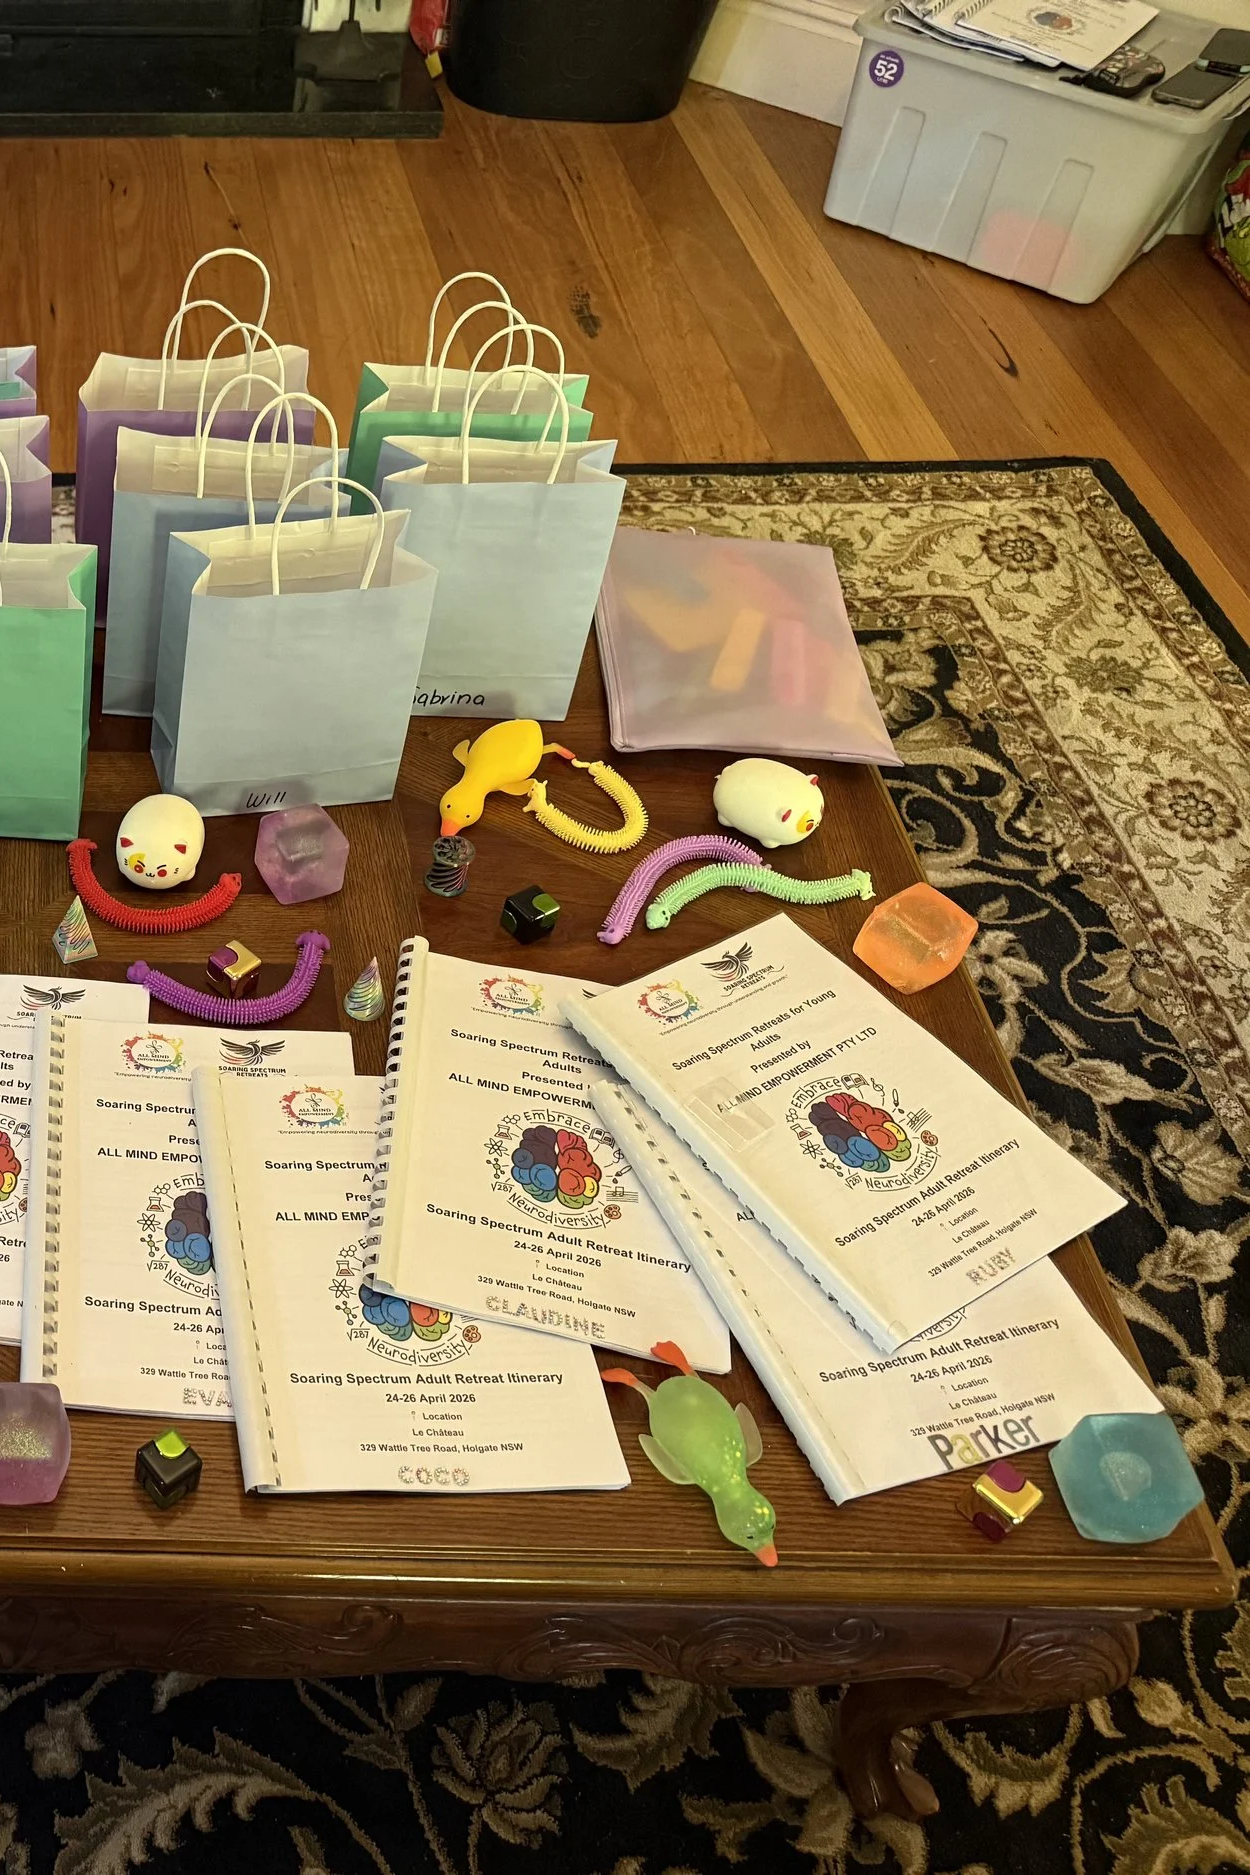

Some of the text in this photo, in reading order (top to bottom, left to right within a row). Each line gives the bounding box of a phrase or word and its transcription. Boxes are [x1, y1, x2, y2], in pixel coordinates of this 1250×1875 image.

[874, 60, 898, 80] 52
[246, 792, 286, 809] Will
[672, 990, 837, 1072] Soaring Spectrum Retreats for Young
[750, 1034, 781, 1051] Adults
[717, 1027, 876, 1114] ALL MIND EMPOWERMENT PTY LTD
[750, 1041, 811, 1073] Presented by
[18, 1080, 31, 1090] by
[793, 1076, 841, 1108] Embrace
[524, 1110, 590, 1133] Embrace
[865, 1147, 941, 1190] Neurodiversity
[835, 1138, 1020, 1246] Soaring Spectrum Adult Retreat Itinerary
[912, 1187, 975, 1226] 24-26 April 2026
[509, 1194, 607, 1228] Neurodiversity
[427, 1204, 693, 1273] Soaring Spectrum Adult Retreat Itinerary
[966, 1248, 1015, 1285] RUBY
[85, 1296, 201, 1315] Soaring Spectrum
[485, 1296, 606, 1339] CLAUDINE
[368, 1338, 469, 1365] Neurodiversity
[819, 1319, 1059, 1382] Soaring Spectrum Adult Retreat Itinerary
[290, 1373, 562, 1386] Soaring Spectrum Adult Retreat Itinerary
[911, 1355, 992, 1382] 24-26 April 2026
[183, 1388, 232, 1407] EVA
[386, 1394, 476, 1405] 24-26 April 2026
[410, 1444, 431, 1452] Tree
[433, 1445, 460, 1453] Road,
[462, 1445, 498, 1453] Holgate
[501, 1443, 523, 1451] NSW
[928, 1415, 1041, 1470] Parker
[398, 1465, 470, 1486] COCO
